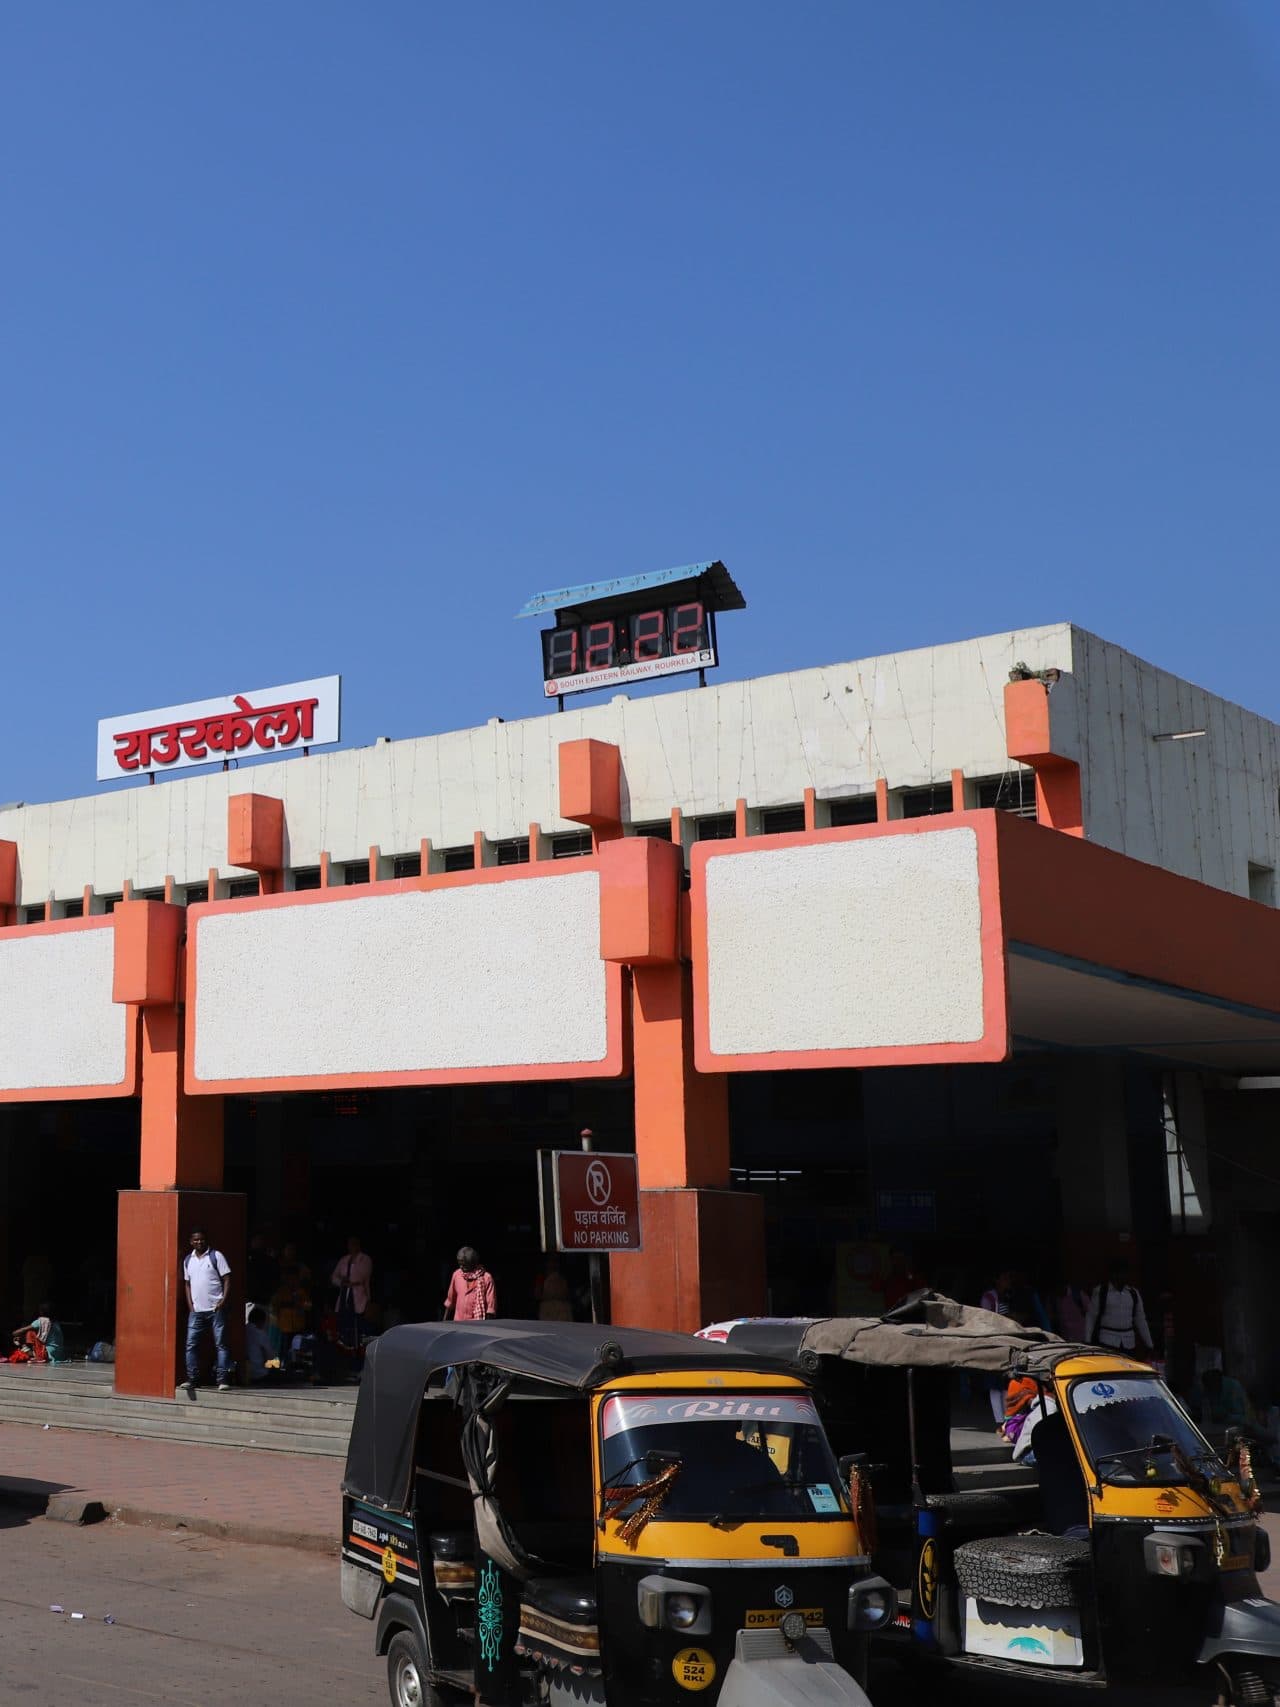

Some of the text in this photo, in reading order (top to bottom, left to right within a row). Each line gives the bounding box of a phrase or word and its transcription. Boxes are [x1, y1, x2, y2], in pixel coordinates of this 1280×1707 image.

[570, 602, 704, 673] 12:22
[559, 678, 584, 689] SOUTH
[585, 671, 619, 684] EASTERN
[655, 656, 697, 671] ROURKELA
[113, 695, 319, 770] राउरकेला
[599, 1205, 626, 1225] वर्जित
[574, 1231, 629, 1244] NO PARKING
[667, 1400, 783, 1418] Ritu
[687, 1652, 701, 1663] A
[683, 1665, 705, 1675] 524
[683, 1674, 705, 1682] RKL
